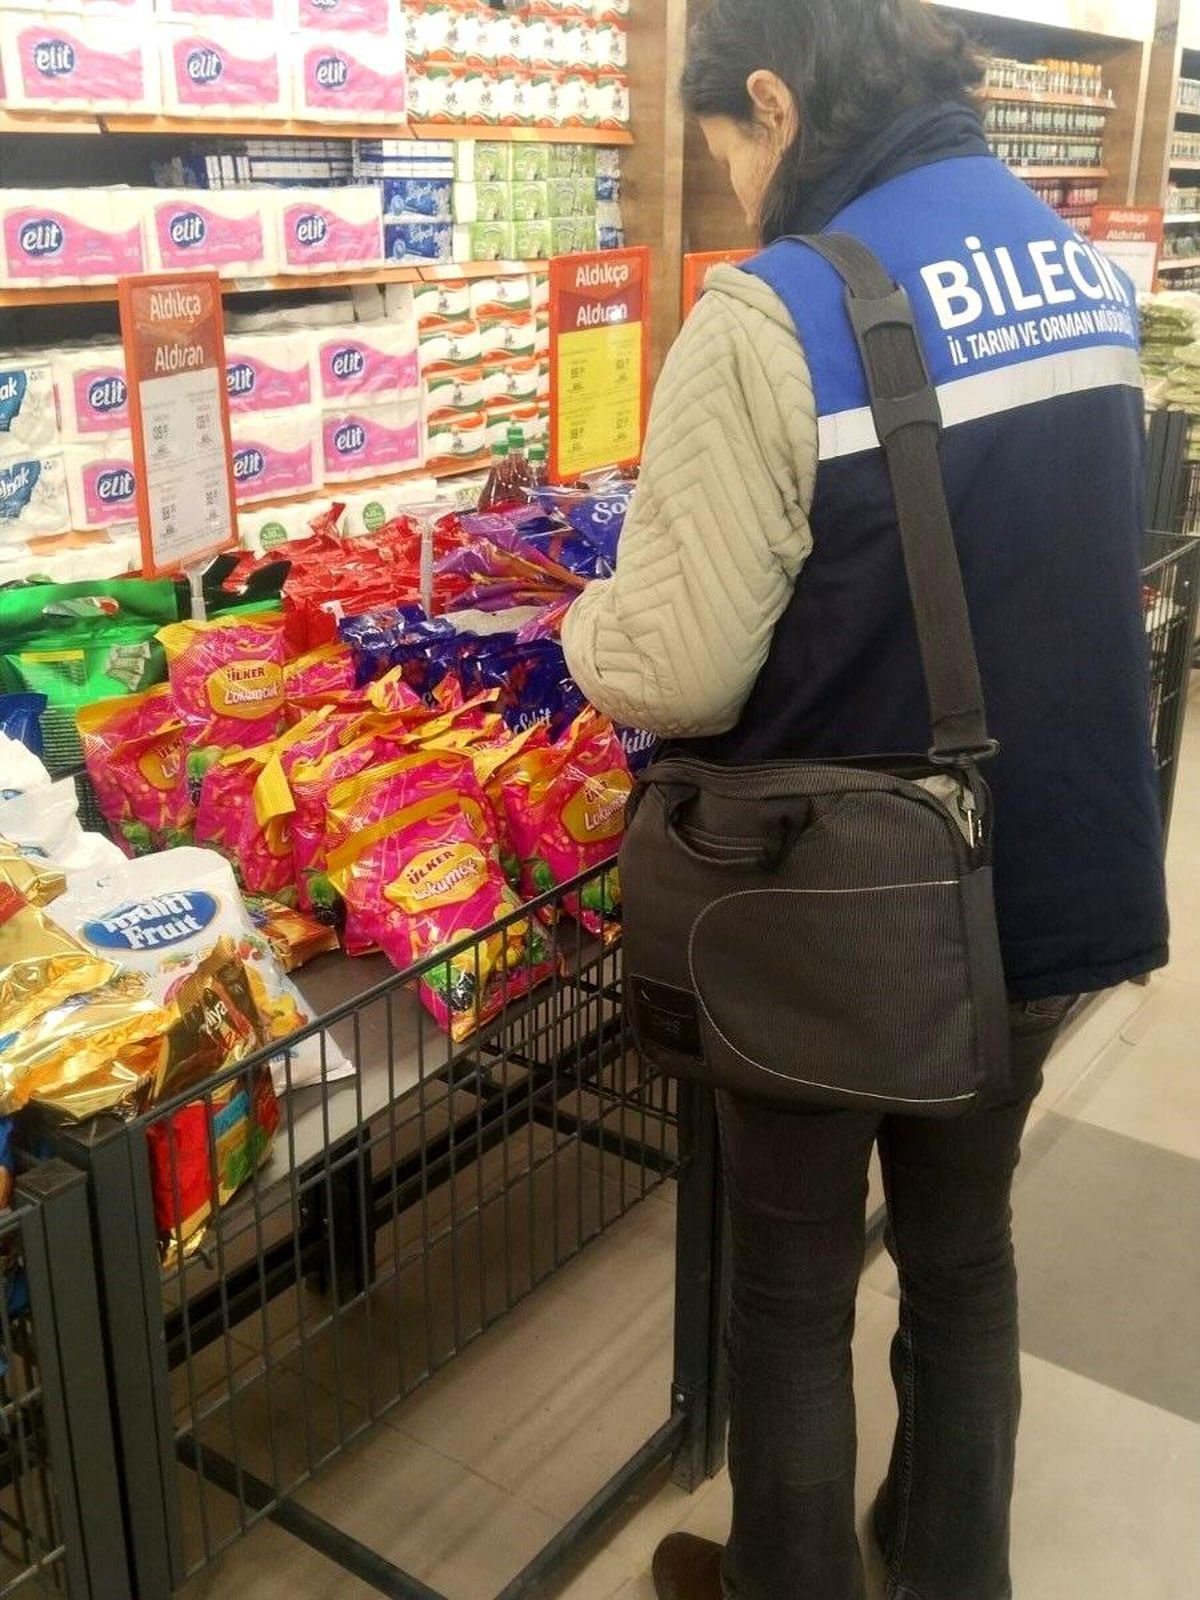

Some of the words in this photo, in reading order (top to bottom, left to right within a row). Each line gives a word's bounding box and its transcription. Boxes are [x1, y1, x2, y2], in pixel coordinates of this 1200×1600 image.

[36, 44, 72, 70] elit
[188, 52, 220, 82] elit
[317, 60, 346, 86] elit
[22, 219, 62, 253] elit
[171, 214, 202, 244] elit
[298, 218, 325, 244] elit
[575, 262, 629, 288] Aldıkça
[150, 290, 201, 323] Aldıkça
[1018, 320, 1041, 348] VE
[1041, 310, 1095, 341] ORMAN
[155, 344, 204, 372] Aldıran
[333, 351, 361, 375] elit
[90, 377, 126, 409] elit
[336, 427, 362, 450] elit
[233, 453, 260, 478] elit
[99, 471, 136, 498] elit
[407, 851, 455, 885] ÜLKER
[121, 914, 203, 949] Fruit
